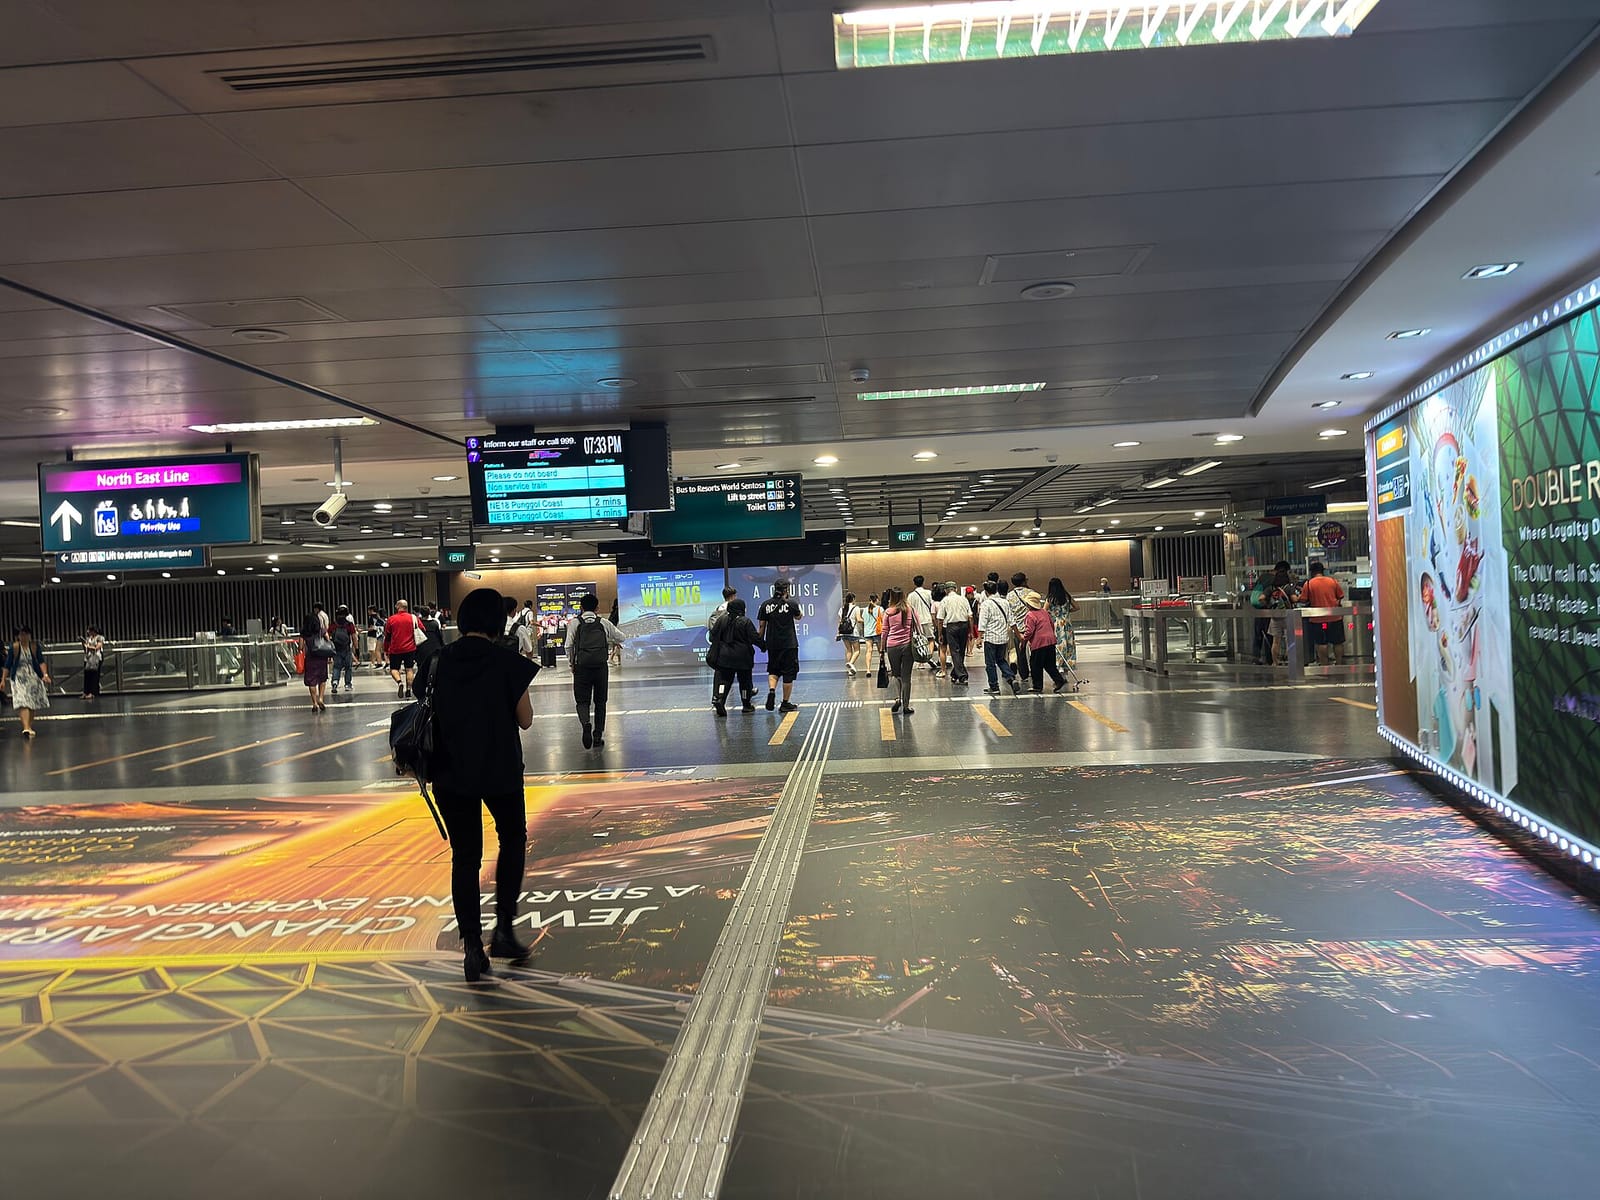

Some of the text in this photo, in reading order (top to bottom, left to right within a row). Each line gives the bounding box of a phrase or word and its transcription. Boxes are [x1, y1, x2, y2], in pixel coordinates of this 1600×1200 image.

[470, 438, 476, 448] 6
[483, 440, 506, 448] Inform
[520, 439, 537, 447] staff
[583, 436, 622, 454] 07:33 PM
[470, 452, 478, 462] 7
[97, 470, 190, 487] North East Line
[486, 472, 511, 480] Please
[537, 469, 557, 477] board
[488, 481, 548, 491] Non service train
[676, 486, 688, 494] Bus
[697, 484, 720, 493] Resorts
[720, 483, 740, 491] World
[740, 482, 765, 490] Sentosa
[1512, 463, 1582, 512] DOUBLE
[727, 493, 738, 501] Lift
[747, 492, 766, 500] street
[490, 502, 510, 510] NE18
[511, 500, 541, 509] Punggol
[542, 499, 563, 507] Coast
[747, 502, 767, 511] Toilet
[491, 512, 511, 521] NE18
[512, 511, 542, 520] Punggol
[543, 510, 564, 519] Coast
[603, 508, 622, 516] mins
[140, 521, 181, 533] Priority Use
[1519, 525, 1547, 542] Where
[1549, 520, 1588, 543] Loyalty
[901, 533, 915, 541] EXIT
[106, 550, 117, 561] Lift
[117, 550, 125, 560] to
[125, 550, 144, 560] street
[452, 554, 465, 562] EXIT
[1513, 564, 1529, 582] The
[1529, 564, 1553, 582] ONLY
[1554, 562, 1576, 582] mall
[1577, 564, 1588, 582] in
[641, 585, 701, 608] WIN BIG
[753, 583, 819, 599] A CUISE
[1520, 595, 1529, 610] to
[1556, 593, 1589, 614] rebate
[1529, 623, 1559, 642] reward
[1560, 628, 1570, 643] at
[664, 884, 702, 898] A
[63, 897, 369, 919] EXPERIENCE
[131, 916, 417, 942] CHANGI
